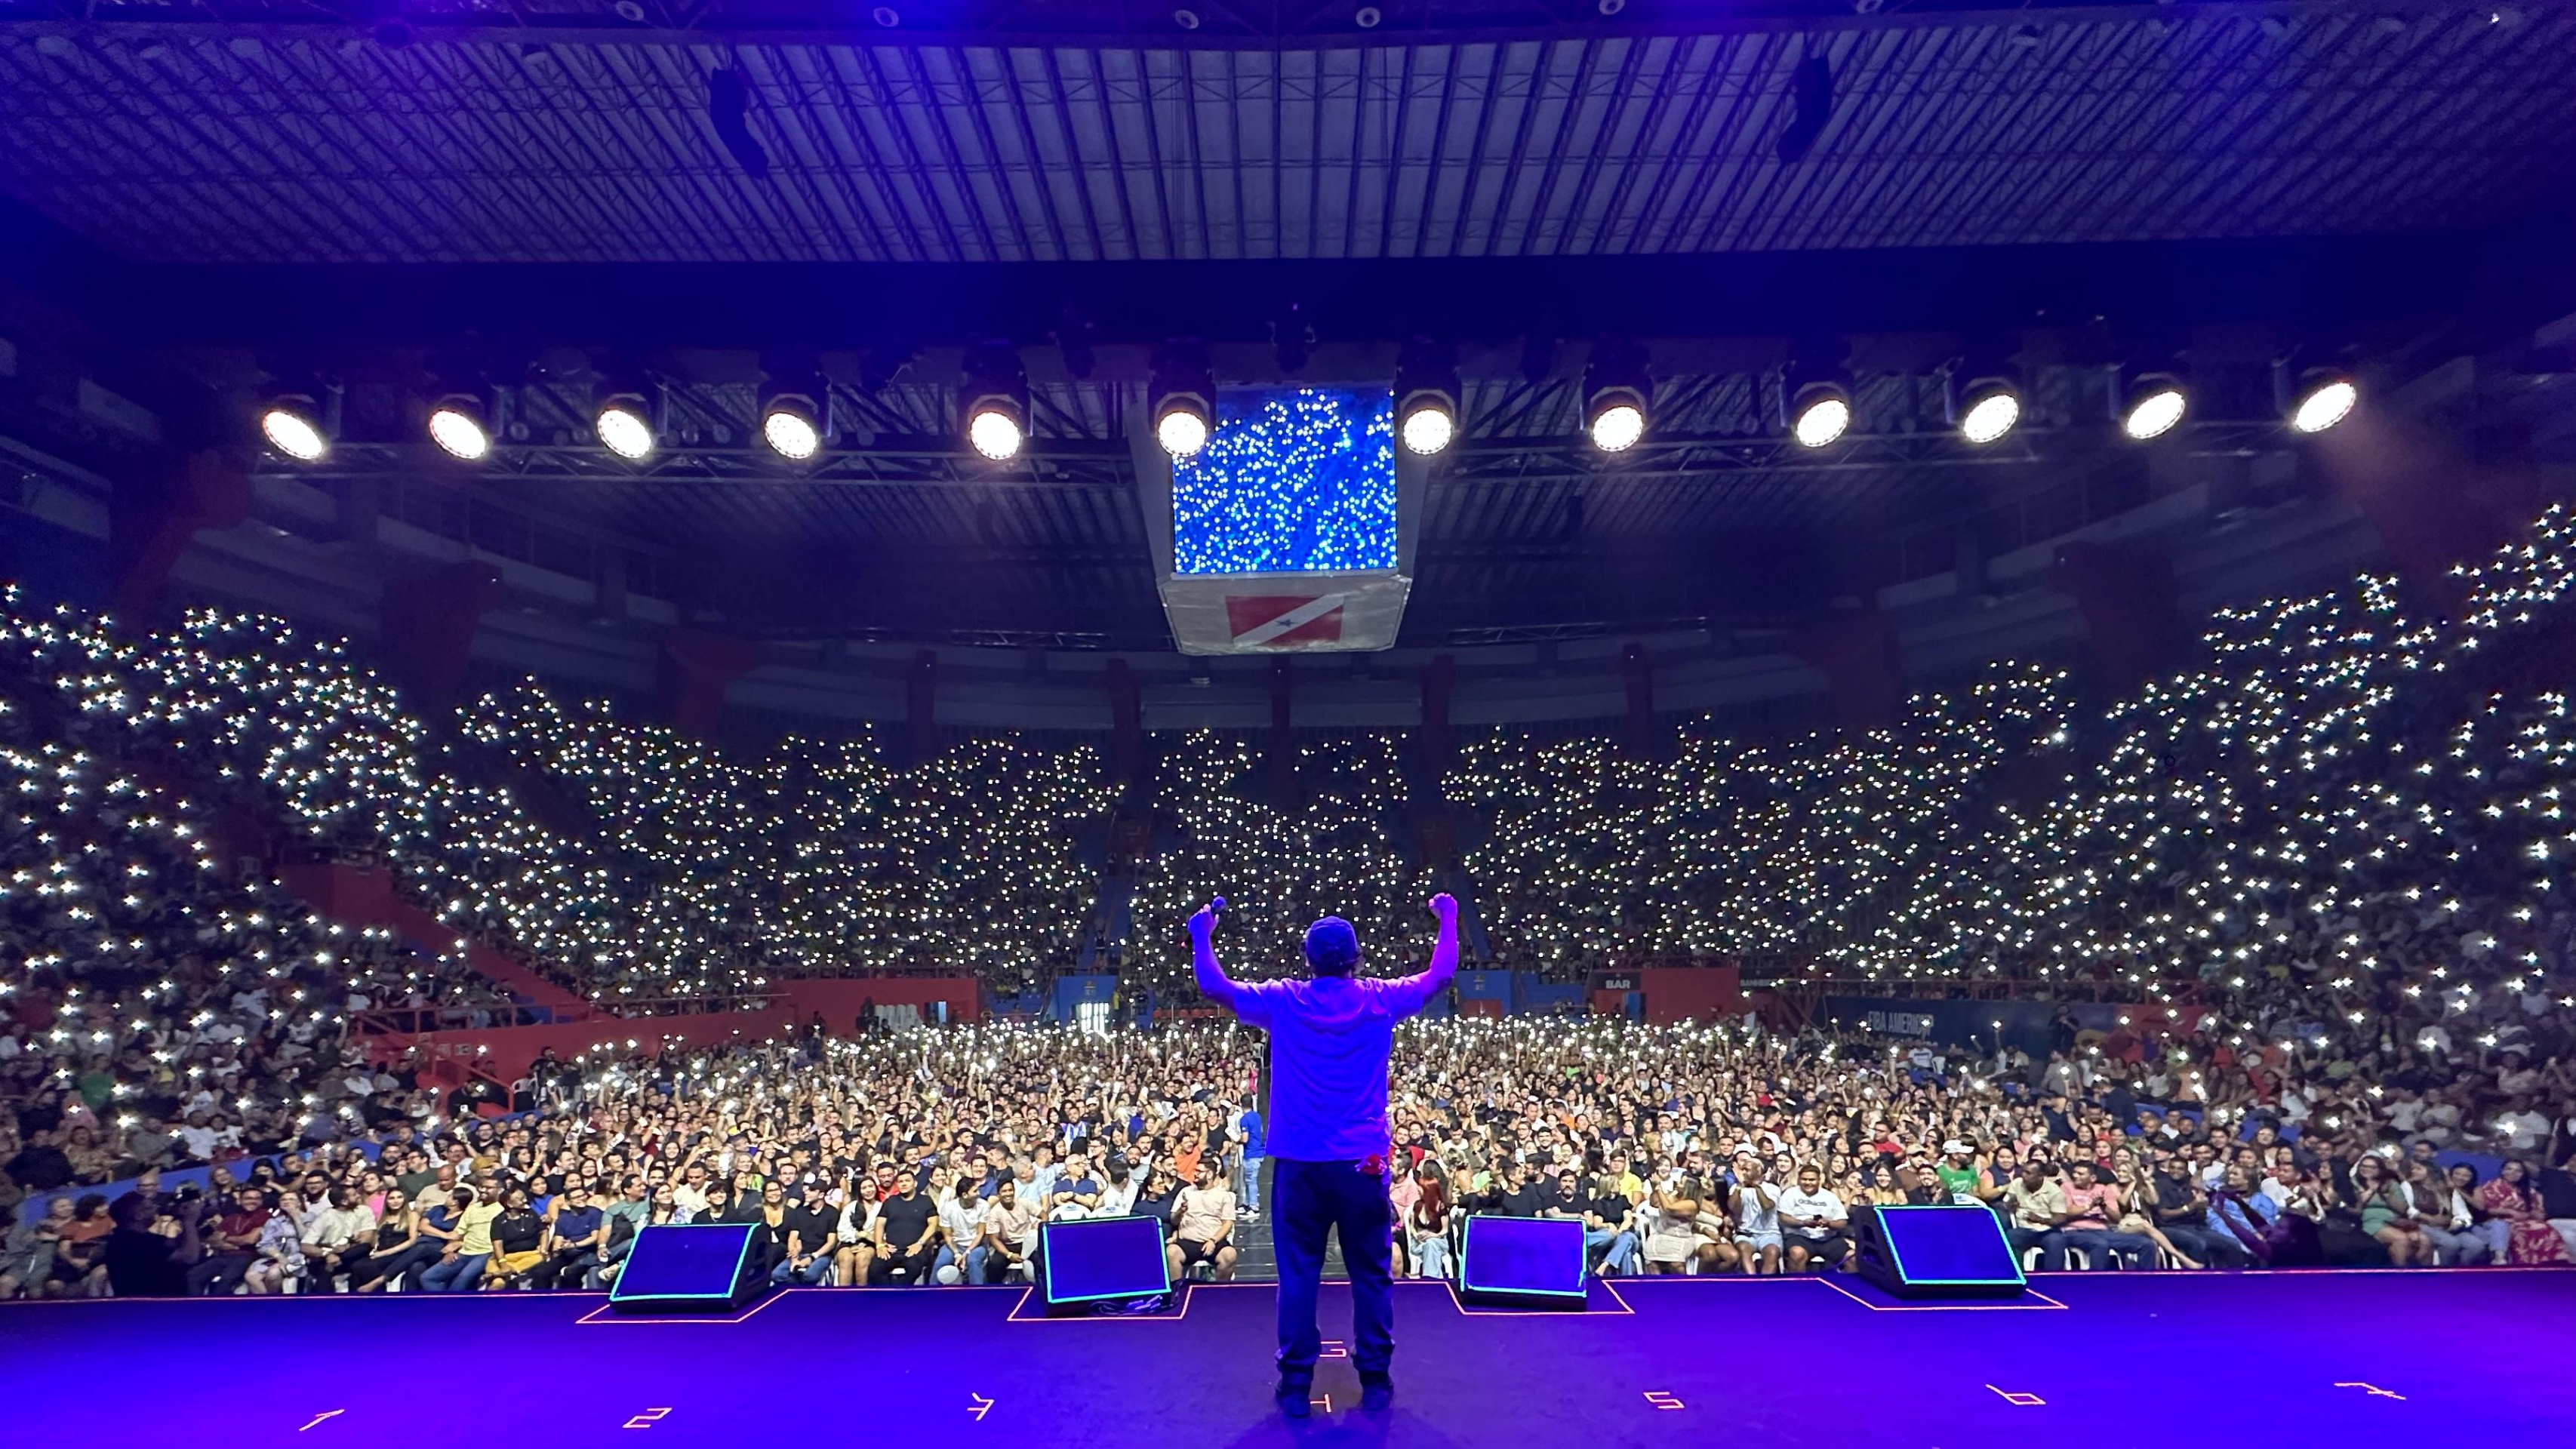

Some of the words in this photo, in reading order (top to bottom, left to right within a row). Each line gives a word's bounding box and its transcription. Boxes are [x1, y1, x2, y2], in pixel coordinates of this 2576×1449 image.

[1605, 980, 1631, 989] BAR
[1888, 1012, 1934, 1036] AMERICP
[1643, 1391, 1685, 1410] 5
[622, 1407, 672, 1429] 2
